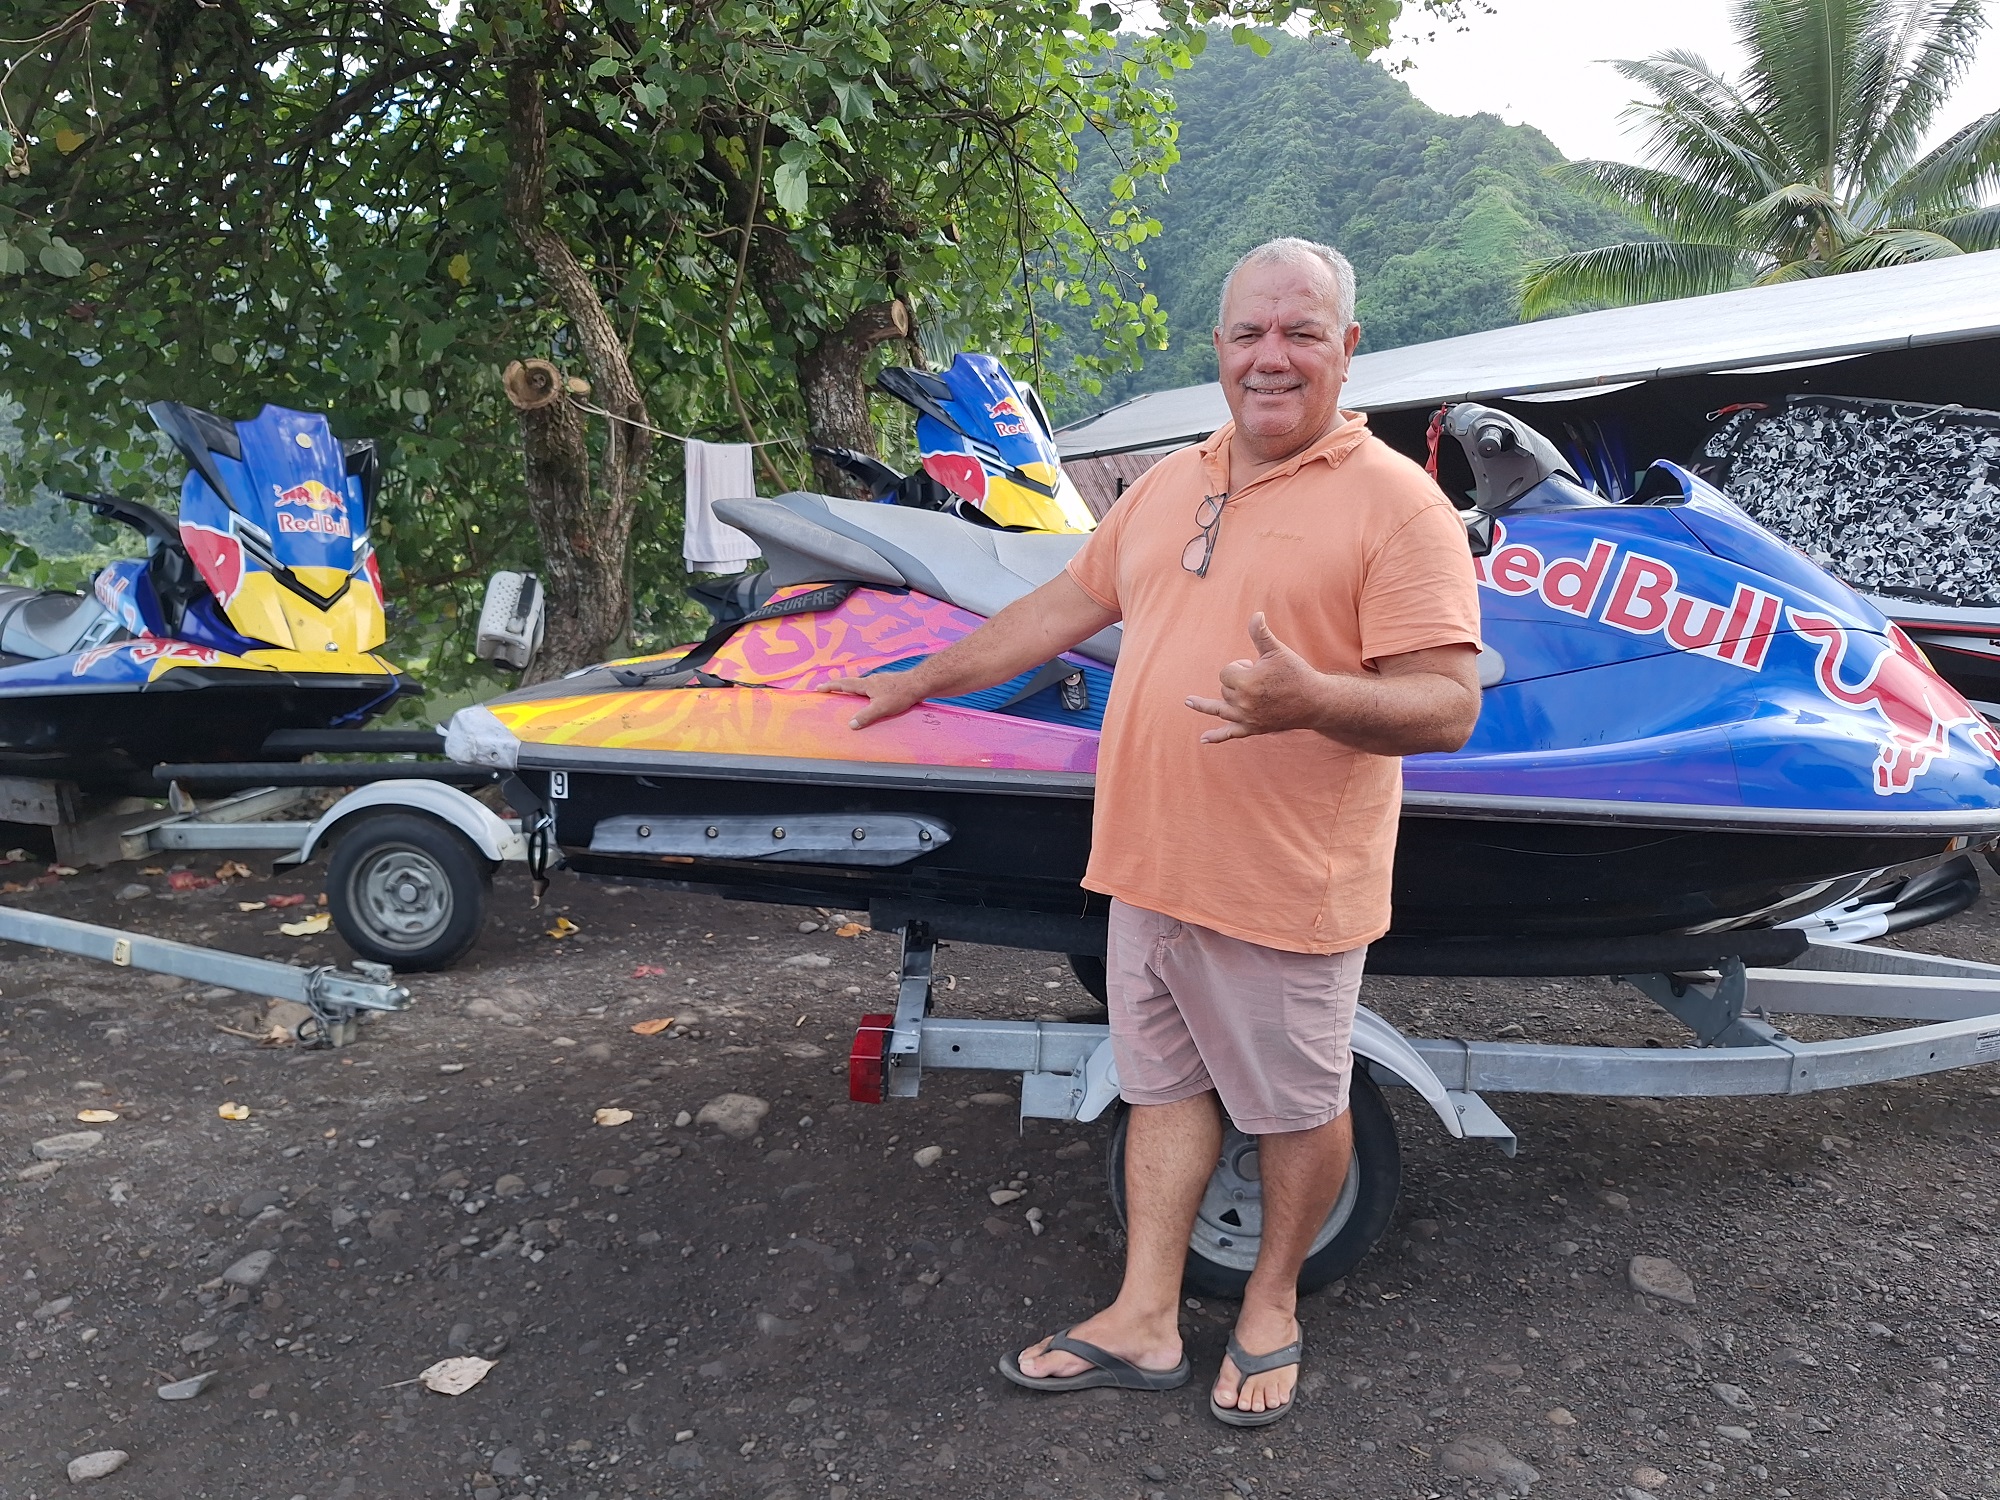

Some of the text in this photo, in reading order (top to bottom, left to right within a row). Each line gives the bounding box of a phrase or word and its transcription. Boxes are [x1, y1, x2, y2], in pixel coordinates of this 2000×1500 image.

[995, 419, 1027, 437] Red
[278, 512, 350, 537] Red Bull
[1602, 553, 1782, 669] Bull
[554, 773, 565, 796] 9
